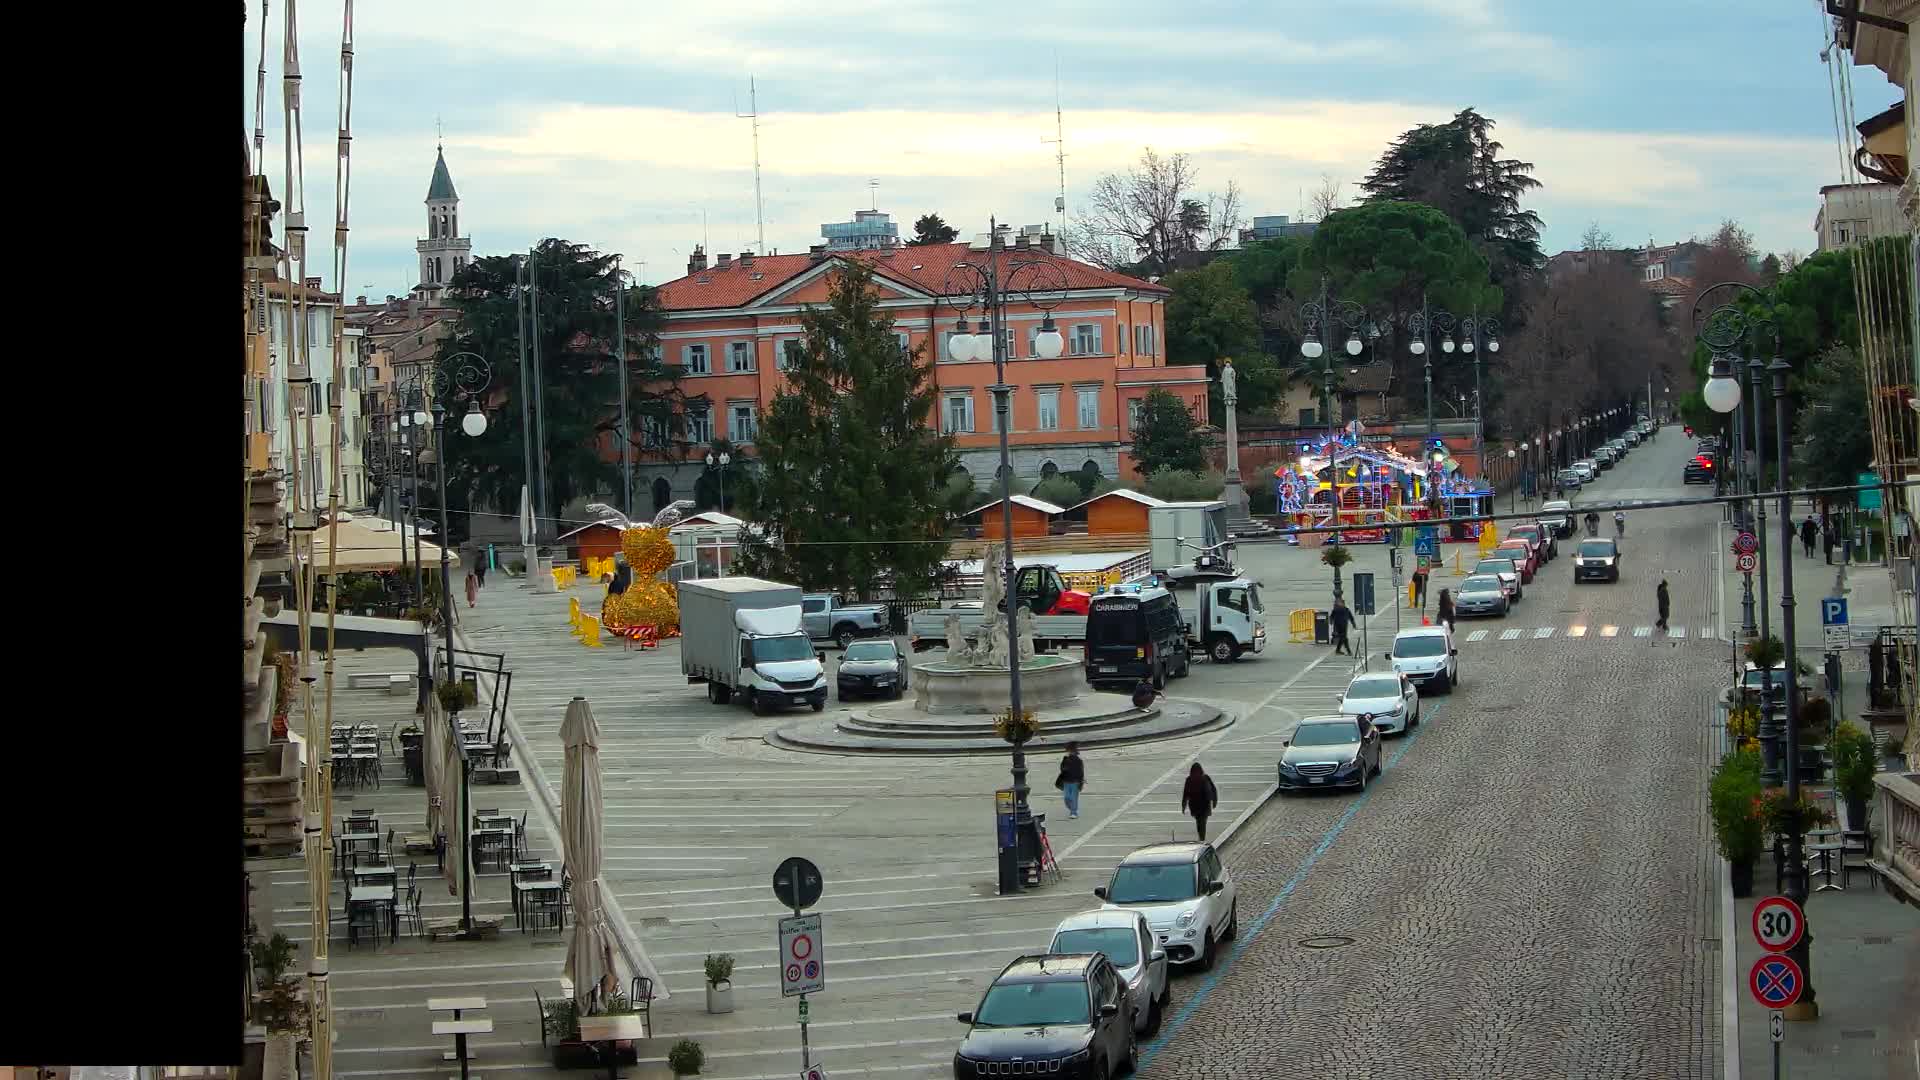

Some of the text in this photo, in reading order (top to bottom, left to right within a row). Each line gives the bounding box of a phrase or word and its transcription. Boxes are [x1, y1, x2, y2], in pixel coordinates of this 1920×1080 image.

[1743, 557, 1753, 567] 20
[1826, 602, 1842, 622] P
[1761, 911, 1792, 938] 30
